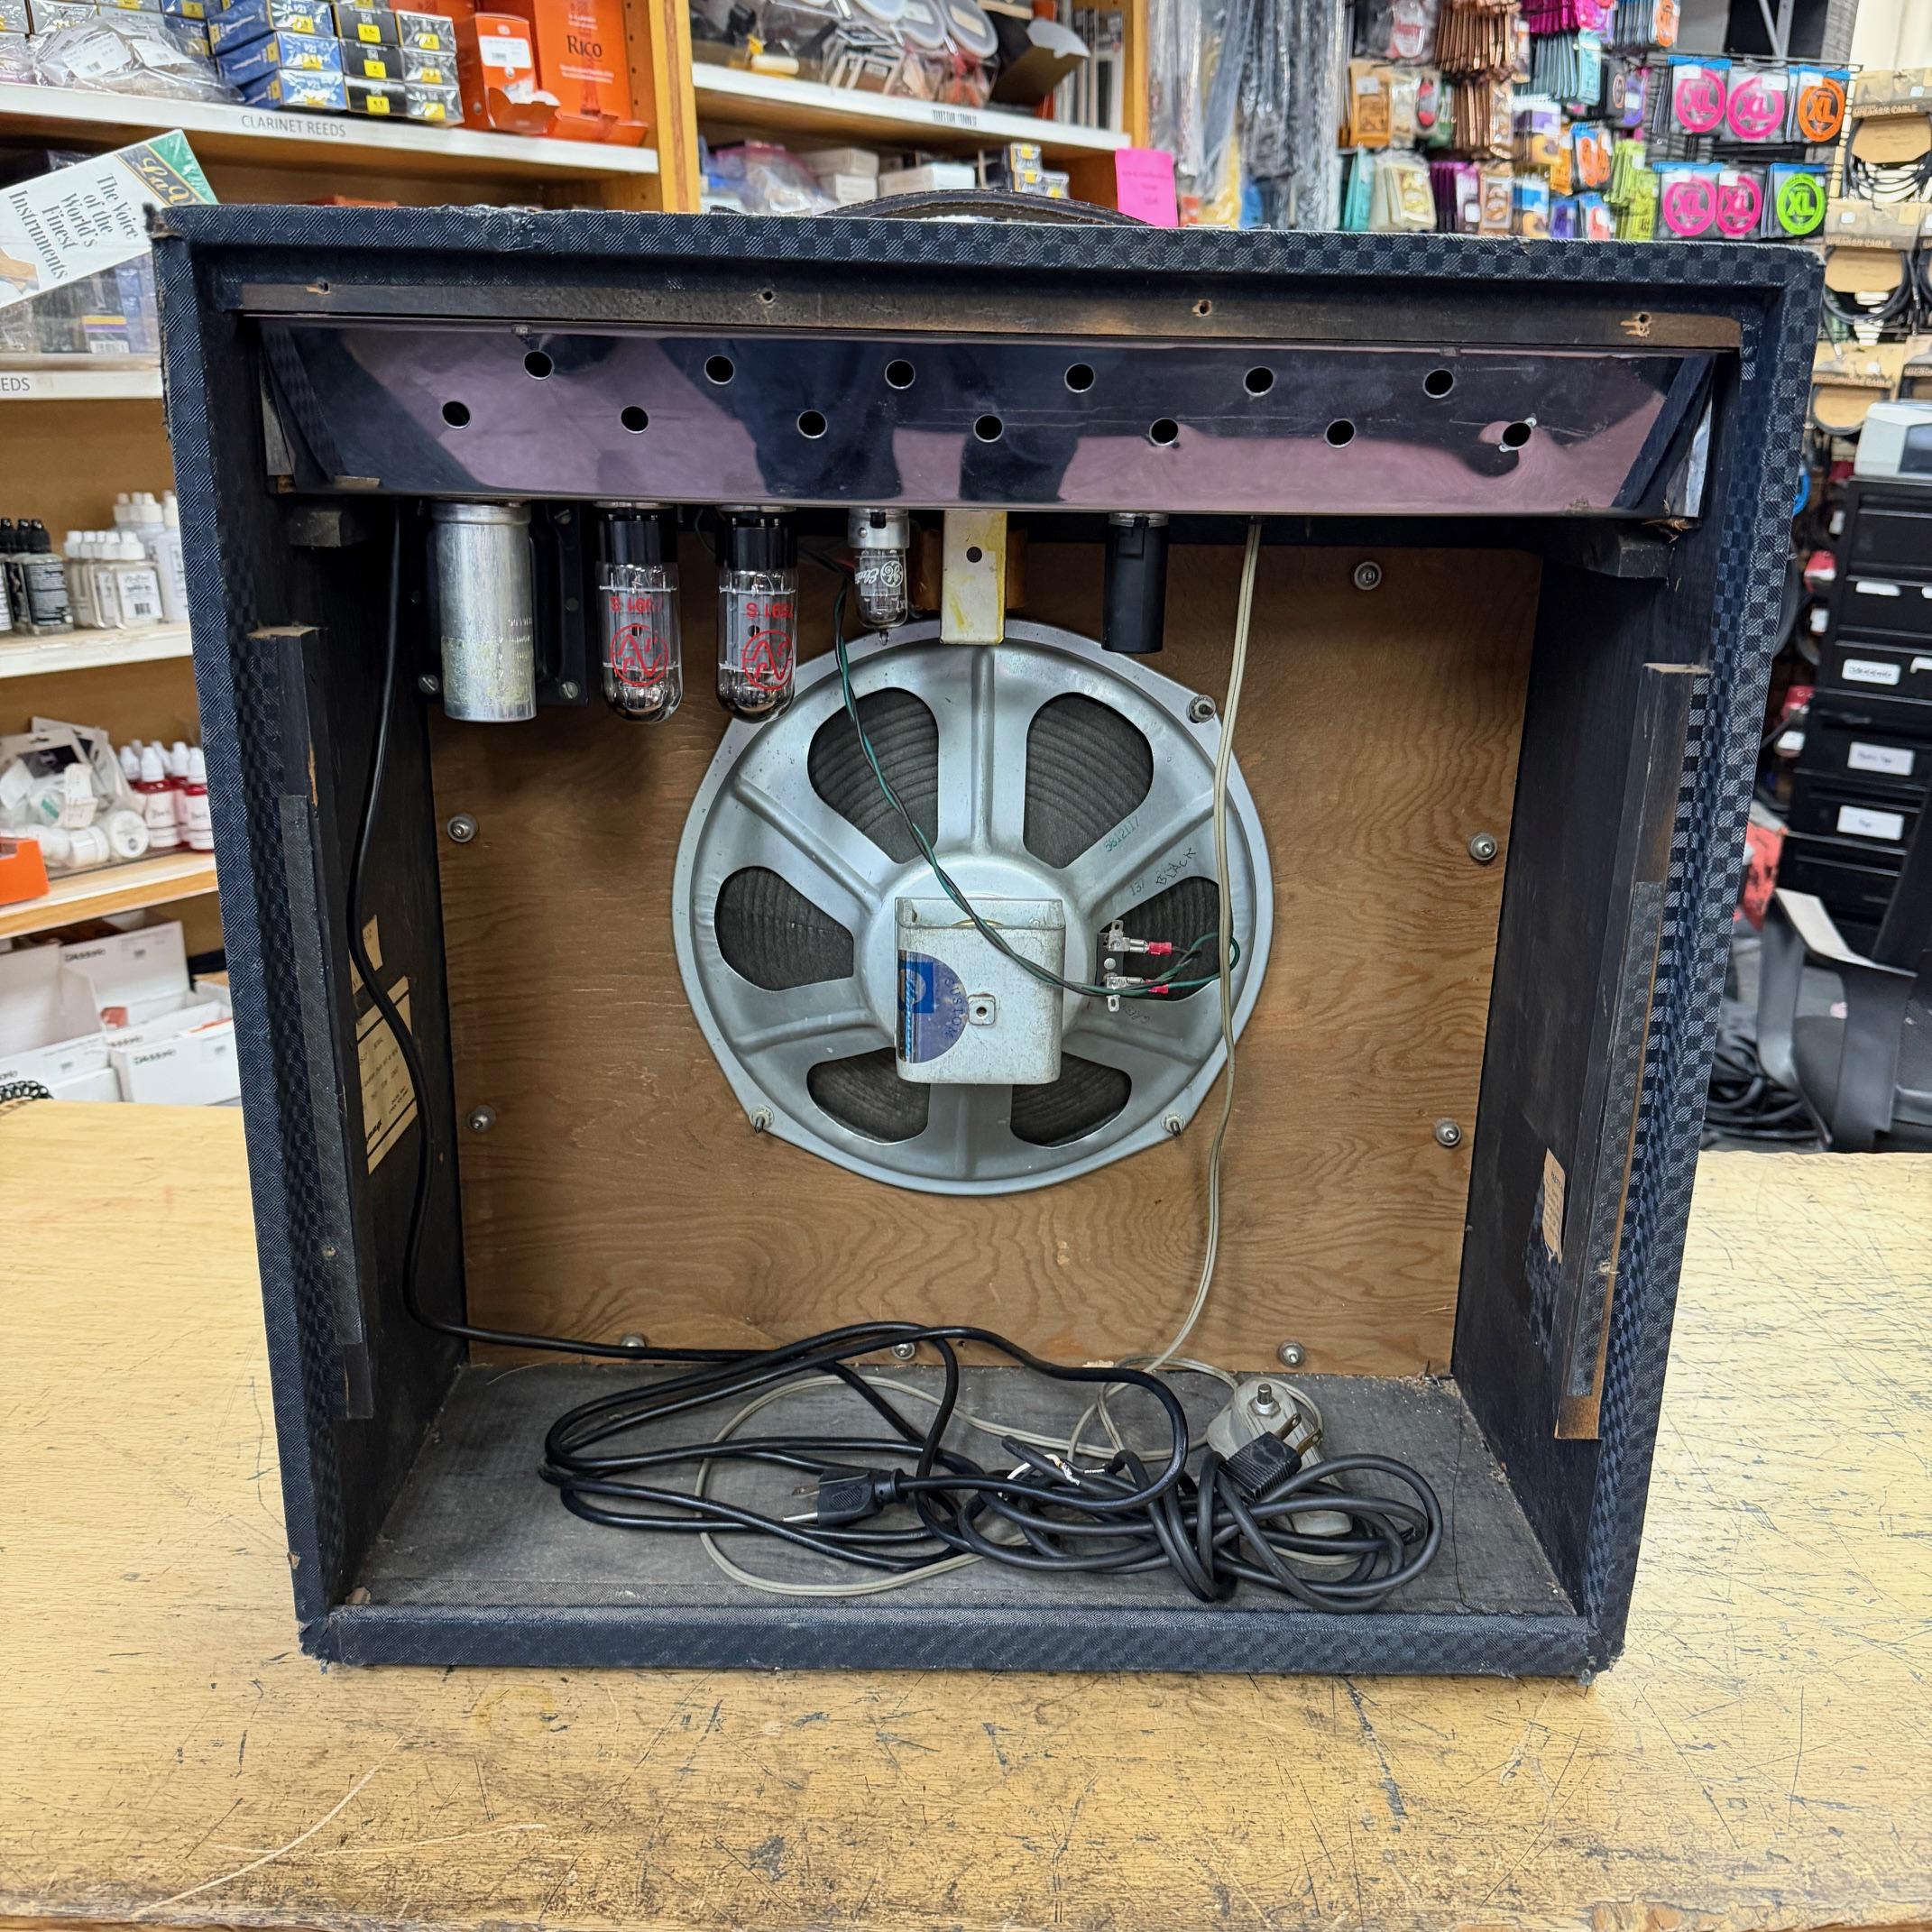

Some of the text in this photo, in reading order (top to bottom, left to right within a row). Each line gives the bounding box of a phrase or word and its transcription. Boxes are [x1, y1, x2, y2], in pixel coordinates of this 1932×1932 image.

[241, 115, 346, 137] CLARINET REEDS
[41, 203, 79, 251] Finest
[60, 191, 101, 248] World's
[82, 193, 115, 235] of the
[96, 172, 139, 240] The Voice
[8, 189, 69, 281] Instruments
[0, 376, 31, 391] EDS
[745, 602, 759, 620] S
[1155, 847, 1196, 886] BLACK
